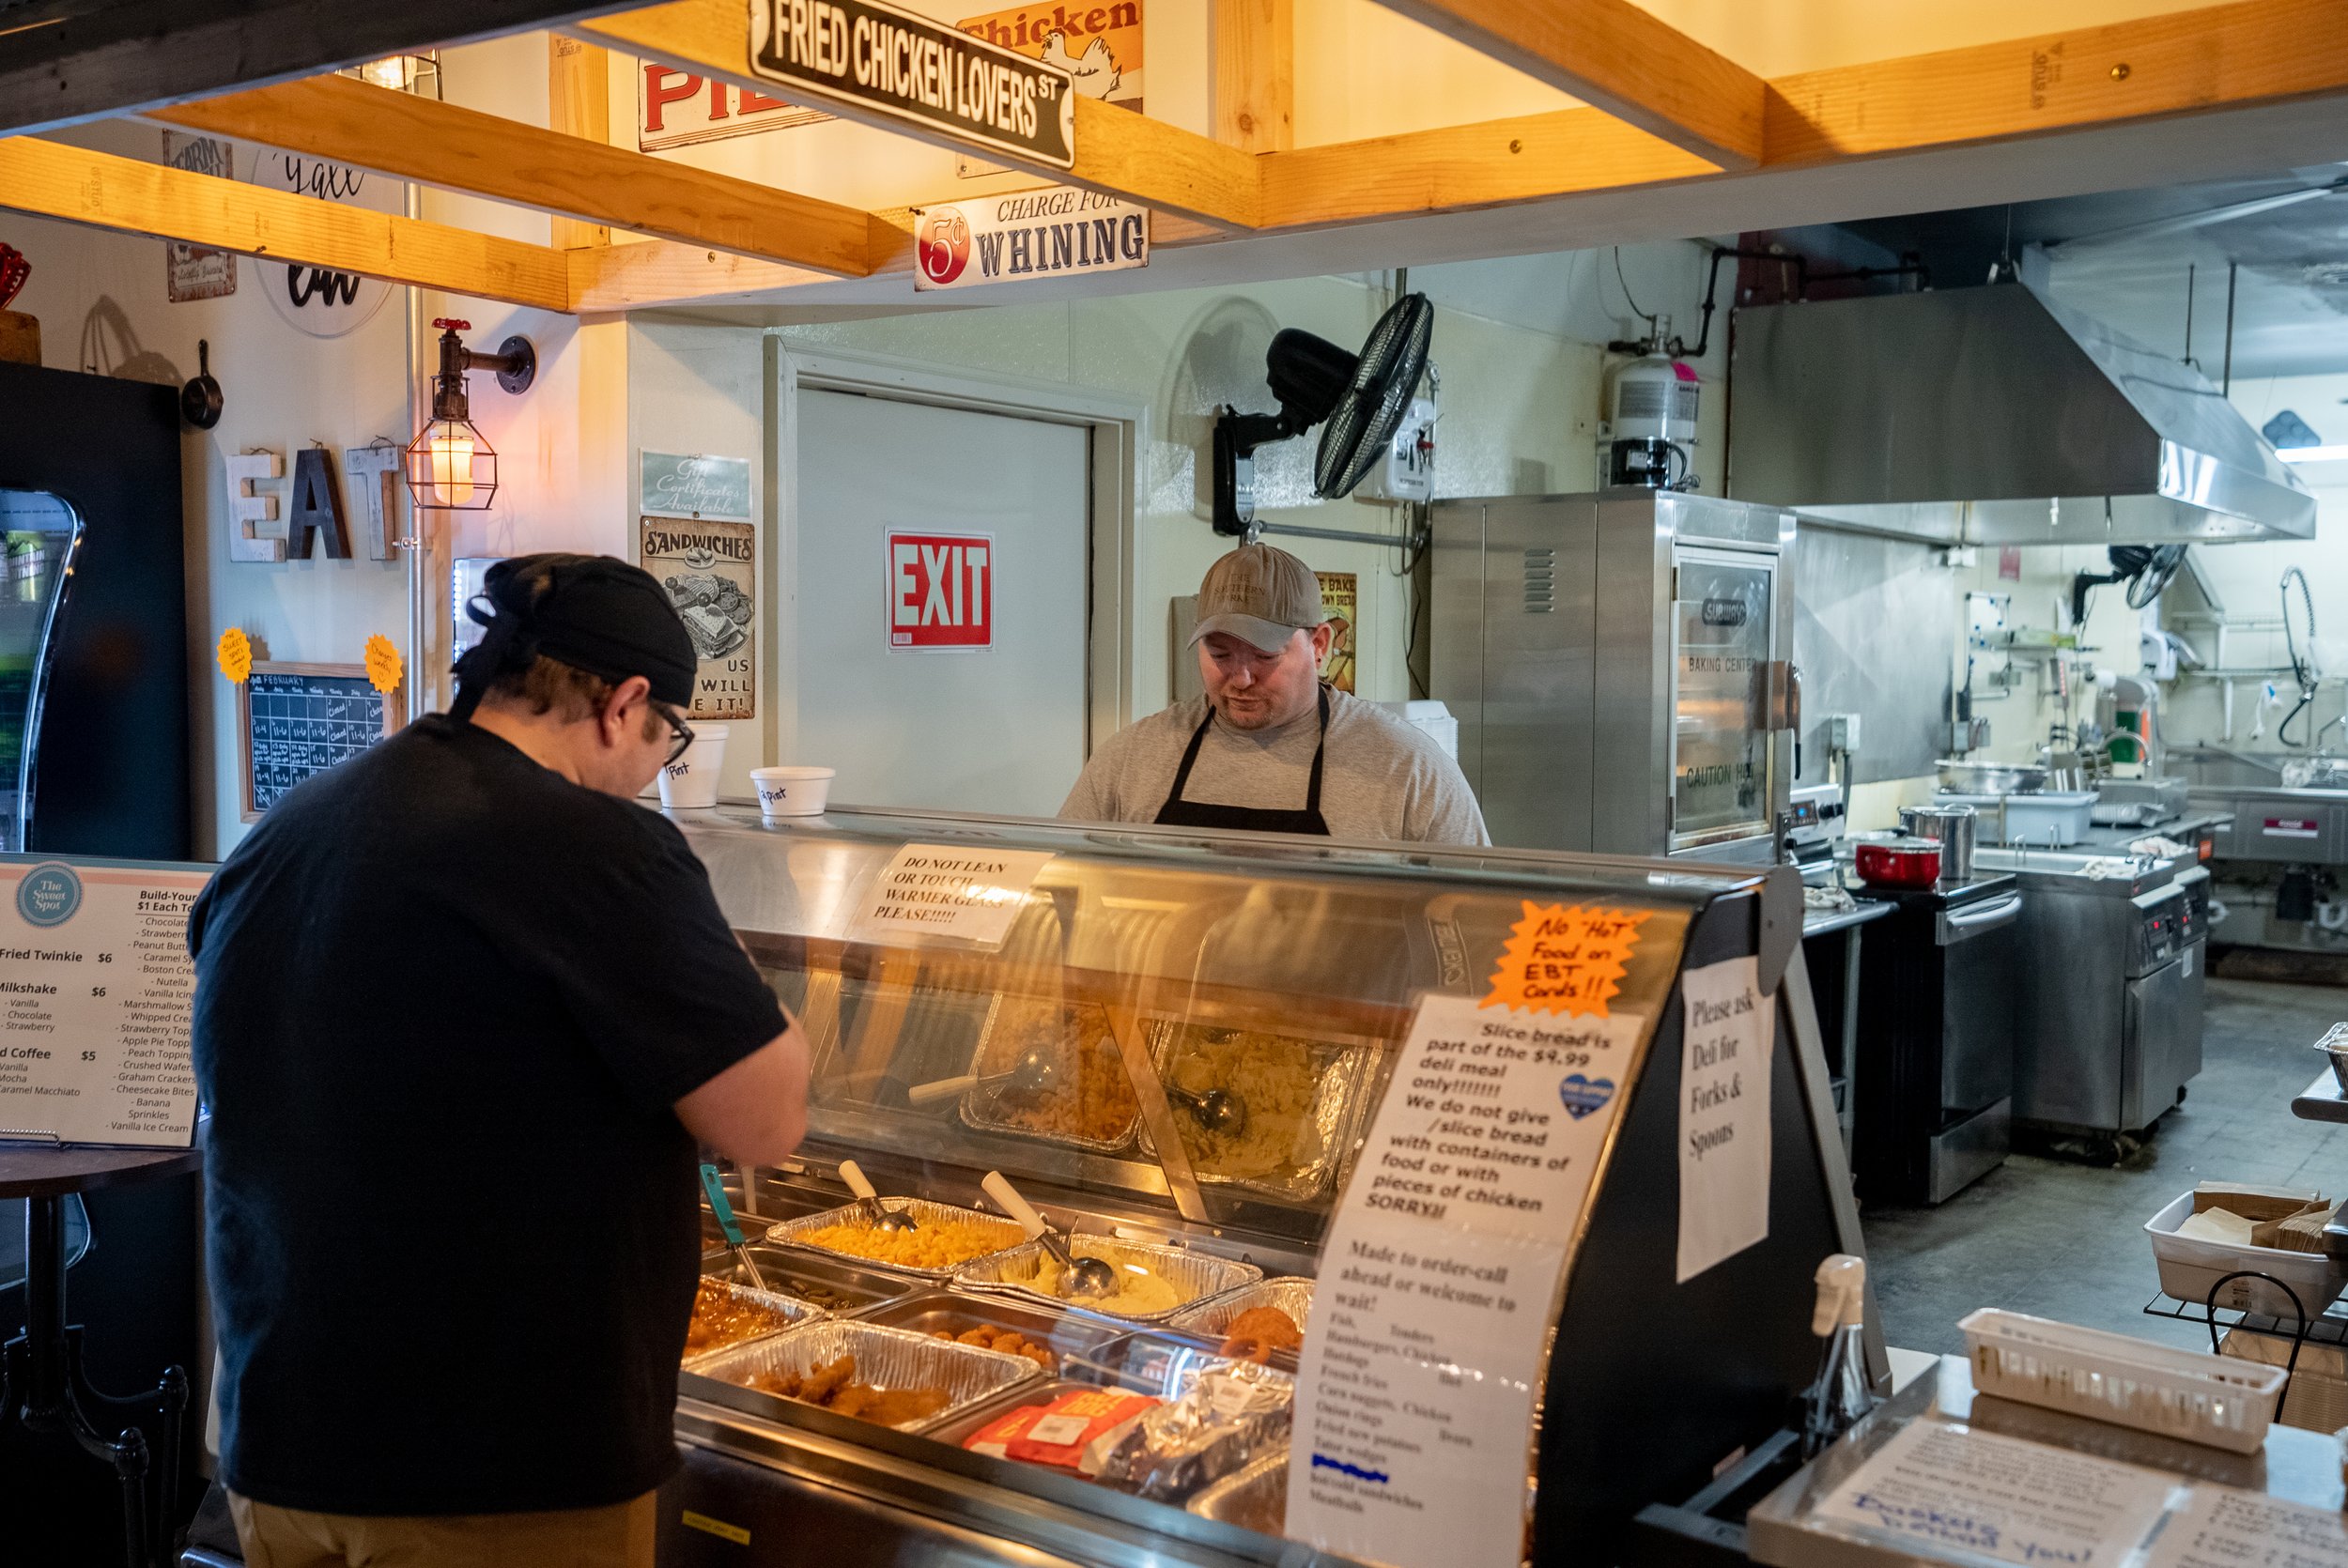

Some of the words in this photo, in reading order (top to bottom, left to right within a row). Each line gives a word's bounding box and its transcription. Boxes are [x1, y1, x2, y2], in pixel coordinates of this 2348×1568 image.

[774, 0, 848, 78] FRIED
[853, 16, 952, 112] CHICKEN
[956, 52, 1037, 139] LOVERS
[1038, 75, 1059, 101] ST
[997, 192, 1074, 223] CHARGE
[975, 214, 1144, 278] WHINING
[657, 474, 740, 498] Certificates
[226, 445, 405, 562] EAT
[653, 493, 734, 513] Available
[644, 530, 752, 561] SANDWICHES
[893, 544, 988, 626] EXIT
[1328, 577, 1356, 592] BAKE
[1704, 600, 1747, 623] SUBWAY
[728, 659, 749, 672] US
[1689, 657, 1722, 672] BAKING
[1724, 657, 1757, 673] CENTER
[701, 679, 750, 692] WILL
[717, 698, 743, 711] IT!
[1686, 763, 1732, 789] CAUTION
[766, 787, 786, 805] pint
[903, 857, 928, 869] DO
[929, 858, 964, 871] NOT
[963, 861, 1008, 874] LEAN
[40, 880, 62, 891] The
[893, 872, 919, 885] OR
[919, 874, 974, 887] TOUCH
[32, 889, 66, 900] Sweet
[140, 890, 197, 901] Build-Your
[886, 888, 952, 905] WARMER
[36, 899, 61, 912] Spot
[137, 901, 149, 911] $1
[152, 902, 178, 912] Each
[141, 929, 187, 939] Strawberr
[1534, 916, 1569, 937] No
[132, 940, 164, 950] Peanut
[1532, 941, 1582, 960] Food
[1587, 949, 1612, 961] on
[0, 948, 31, 960] Fried
[34, 949, 83, 962] Twinkie
[98, 952, 113, 963] $6
[143, 952, 180, 962] Caramel
[143, 964, 174, 974] Boston
[177, 966, 195, 976] Crea
[1524, 962, 1584, 980] EBT
[156, 976, 189, 987] Nutella
[91, 987, 106, 997] $6
[144, 989, 174, 997] Vanilla
[1523, 981, 1577, 999] Cards
[10, 999, 39, 1008] Vanilla
[123, 1000, 185, 1010] Marshmallow
[1692, 997, 1731, 1029] Please
[1733, 987, 1754, 1015] ask
[8, 1010, 53, 1021] Chocolate
[131, 1012, 171, 1023] Whipped
[173, 1014, 193, 1023] Crea
[6, 1022, 55, 1033] Strawberry
[120, 1023, 171, 1036] Strawberry
[122, 1036, 148, 1046] Apple
[150, 1038, 164, 1046] Pie
[167, 1038, 193, 1049] Topp
[1481, 1022, 1527, 1041] Slice
[1533, 1029, 1589, 1049] bread
[1595, 1033, 1611, 1050] is
[10, 1047, 52, 1059] Coffee
[81, 1050, 97, 1061] $5
[128, 1048, 155, 1057] Peach
[1426, 1038, 1466, 1053] part
[1471, 1041, 1491, 1055] of
[1496, 1045, 1528, 1061] the
[1691, 1038, 1718, 1071] Deli
[1719, 1034, 1739, 1062] for
[123, 1060, 162, 1070] Crushed
[1419, 1056, 1454, 1072] deli
[1459, 1061, 1507, 1078] meal
[118, 1072, 155, 1083] Graham
[158, 1073, 196, 1084] Crackers
[35, 1086, 81, 1097] Macchiato
[116, 1084, 170, 1096] Cheesecake
[172, 1087, 194, 1096] Bites
[1691, 1079, 1728, 1115] Forks
[1729, 1071, 1741, 1099] &
[136, 1098, 171, 1108] Banana
[1406, 1094, 1435, 1111] We
[1440, 1099, 1464, 1115] do
[1470, 1104, 1502, 1119] not
[1507, 1109, 1551, 1127] give
[128, 1110, 170, 1120] Sprinkles
[111, 1121, 141, 1131] Vanilla
[143, 1123, 157, 1131] Ice
[159, 1123, 189, 1133] Cream
[1490, 1127, 1549, 1147] bread
[1689, 1121, 1734, 1162] Spoons
[1390, 1134, 1431, 1152] with
[1437, 1139, 1542, 1168] containers
[1546, 1156, 1570, 1173] of
[1381, 1152, 1425, 1172] food
[1429, 1161, 1451, 1175] or
[1457, 1164, 1501, 1184] with
[1372, 1174, 1434, 1195] pieces
[1440, 1183, 1461, 1198] of
[1464, 1188, 1543, 1213] chicken
[1349, 1239, 1397, 1263] Made
[1400, 1252, 1418, 1268] to
[1339, 1266, 1393, 1289] ahead
[1394, 1278, 1414, 1292] or
[1418, 1283, 1494, 1308] welcome
[1497, 1296, 1517, 1314] to
[1335, 1292, 1378, 1313] wait!
